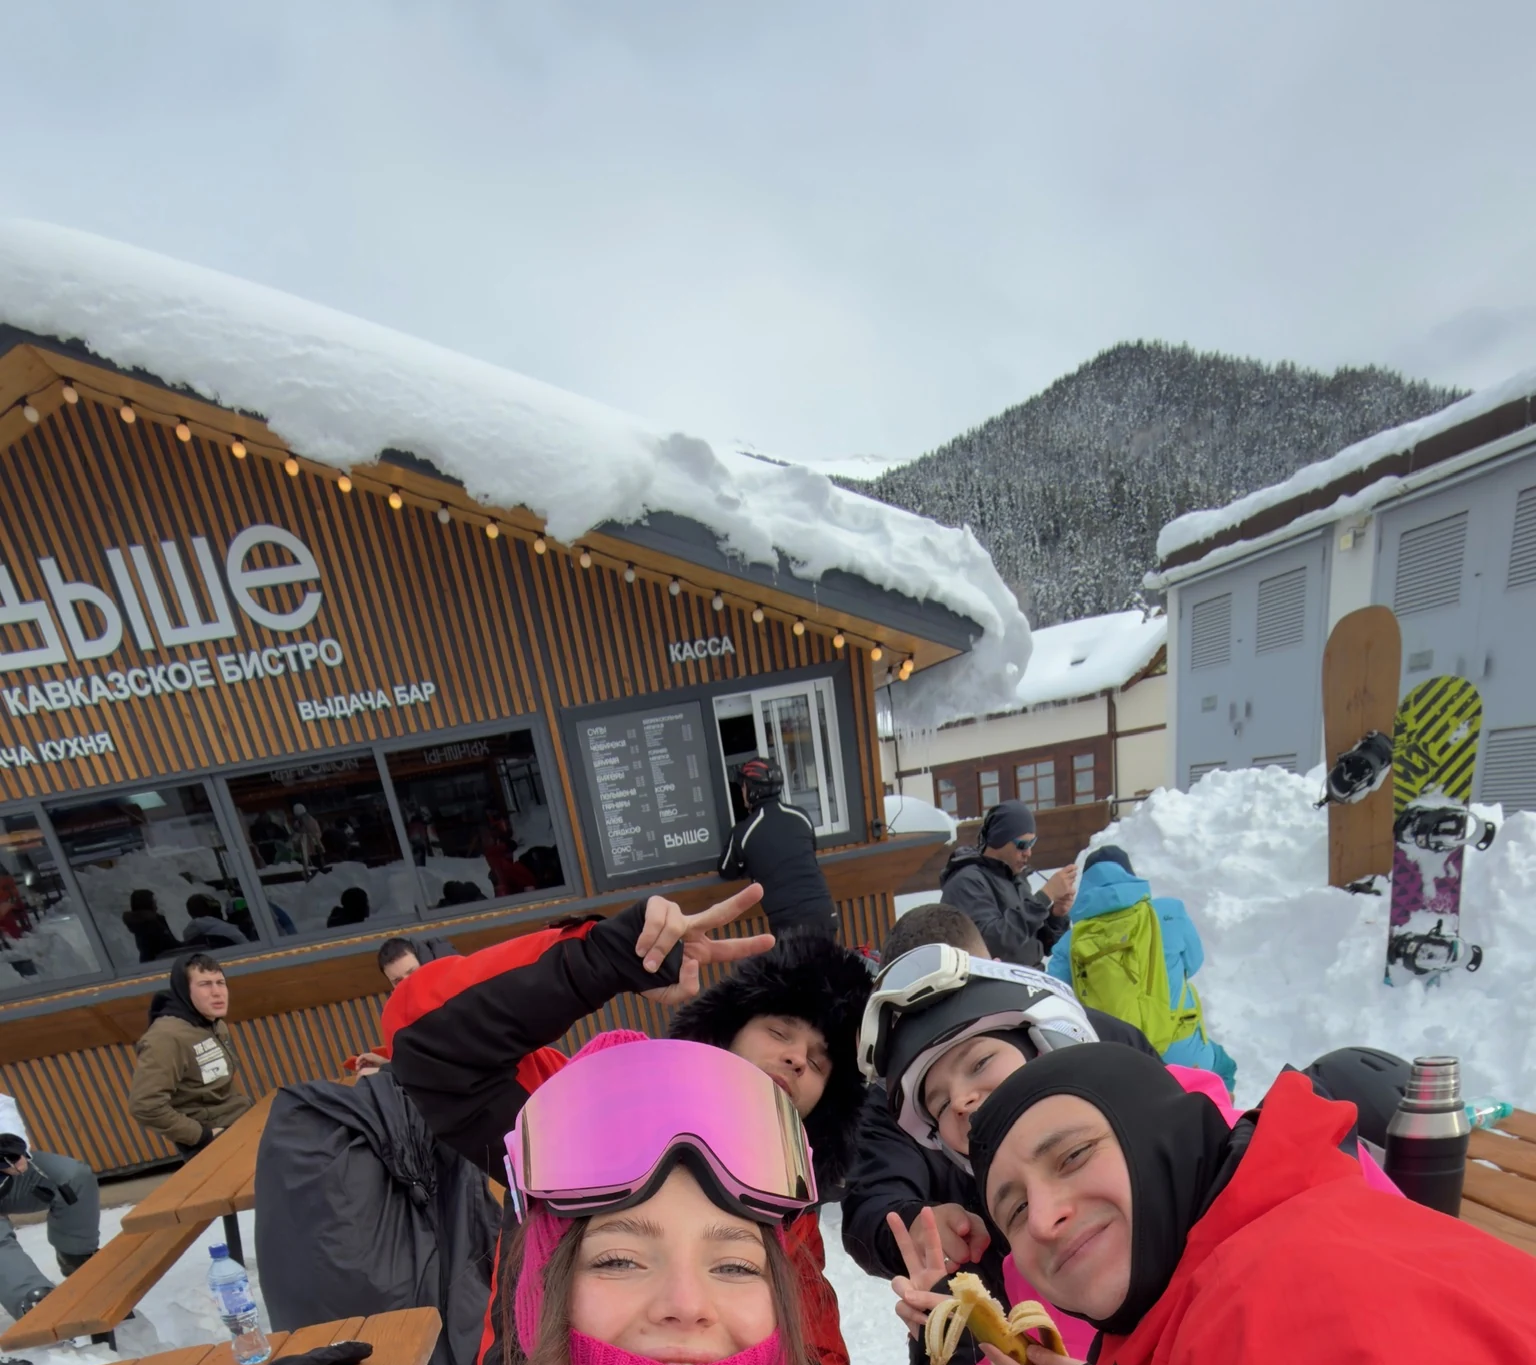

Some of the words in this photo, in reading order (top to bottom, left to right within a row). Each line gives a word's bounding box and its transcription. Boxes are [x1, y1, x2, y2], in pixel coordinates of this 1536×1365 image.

[669, 636, 735, 663] КАССА
[2, 658, 217, 717] КАВКАЗСКОЕ
[217, 639, 344, 684] БИСТРО
[299, 690, 391, 722] ВЫДАЧА
[394, 681, 436, 706] БАР
[38, 731, 116, 762] КУХНЯ
